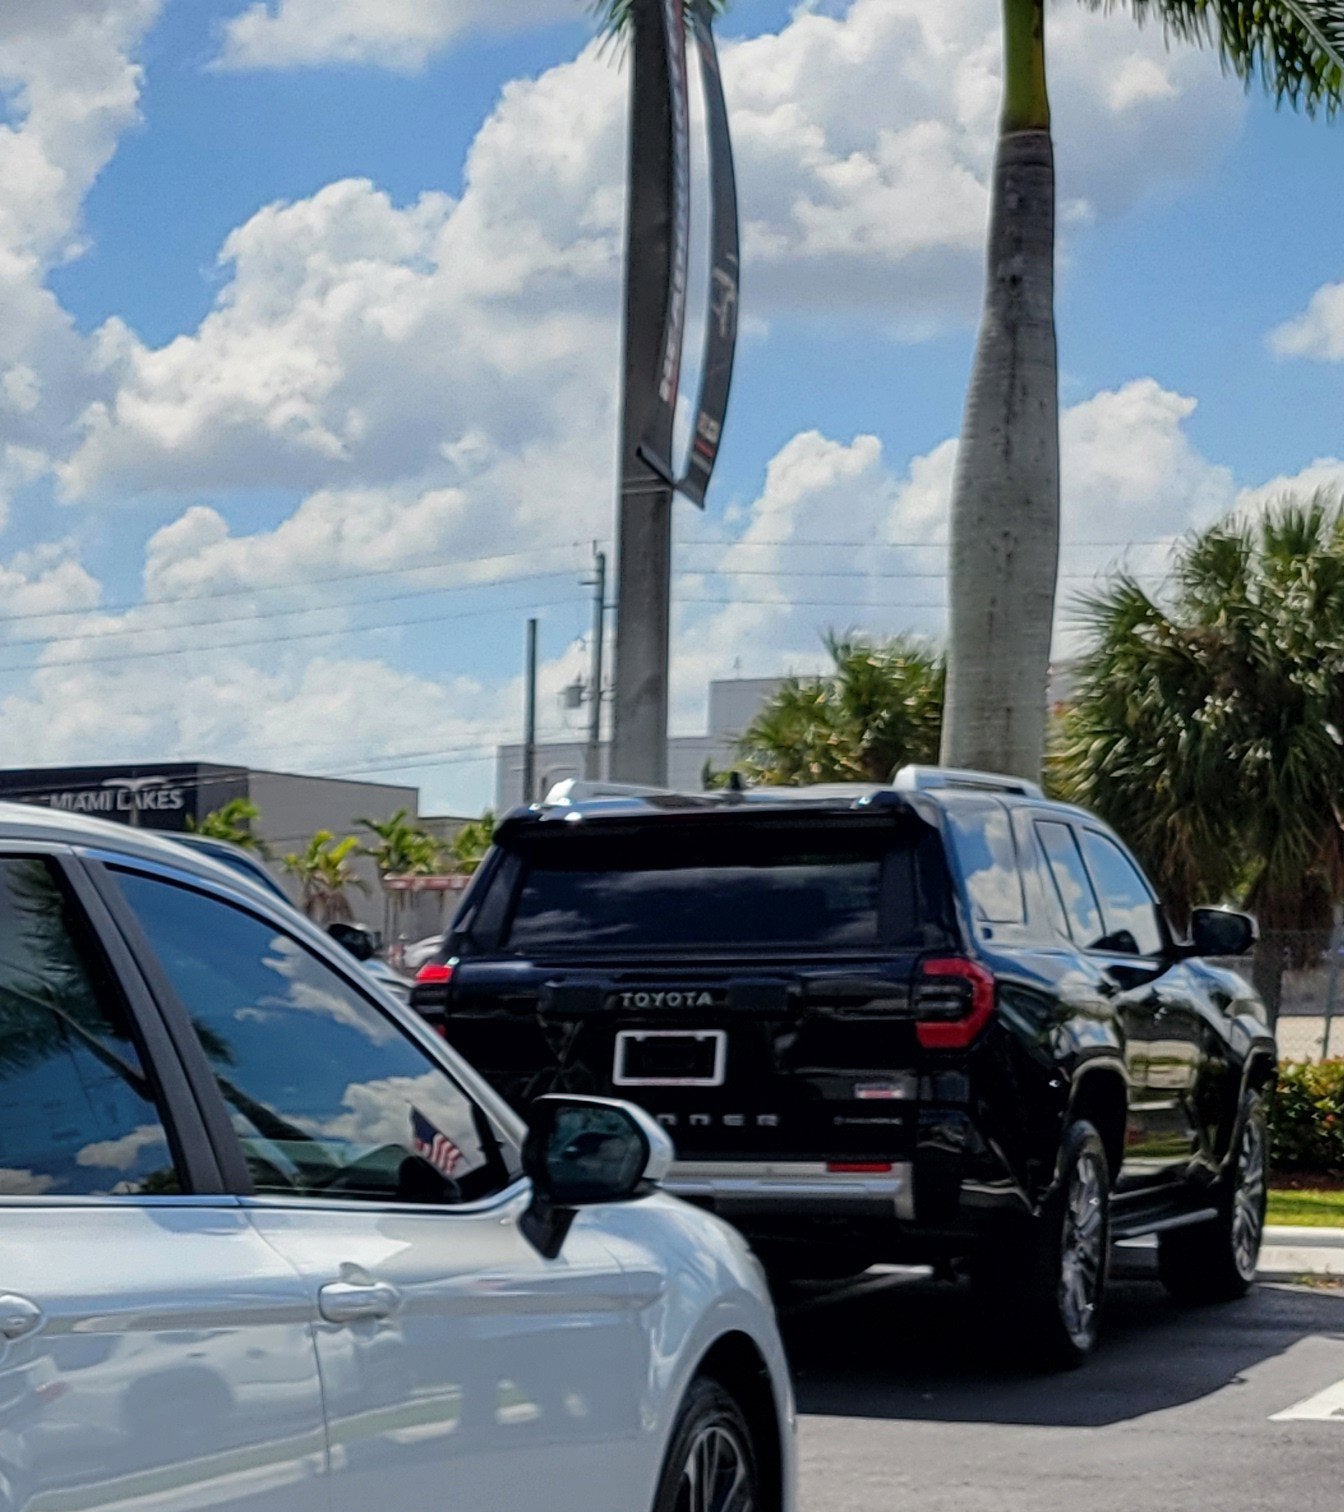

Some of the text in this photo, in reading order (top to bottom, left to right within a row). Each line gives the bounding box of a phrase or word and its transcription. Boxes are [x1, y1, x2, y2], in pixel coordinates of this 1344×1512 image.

[50, 789, 184, 812] MIAMI LAKES
[619, 991, 712, 1008] TOYOTA
